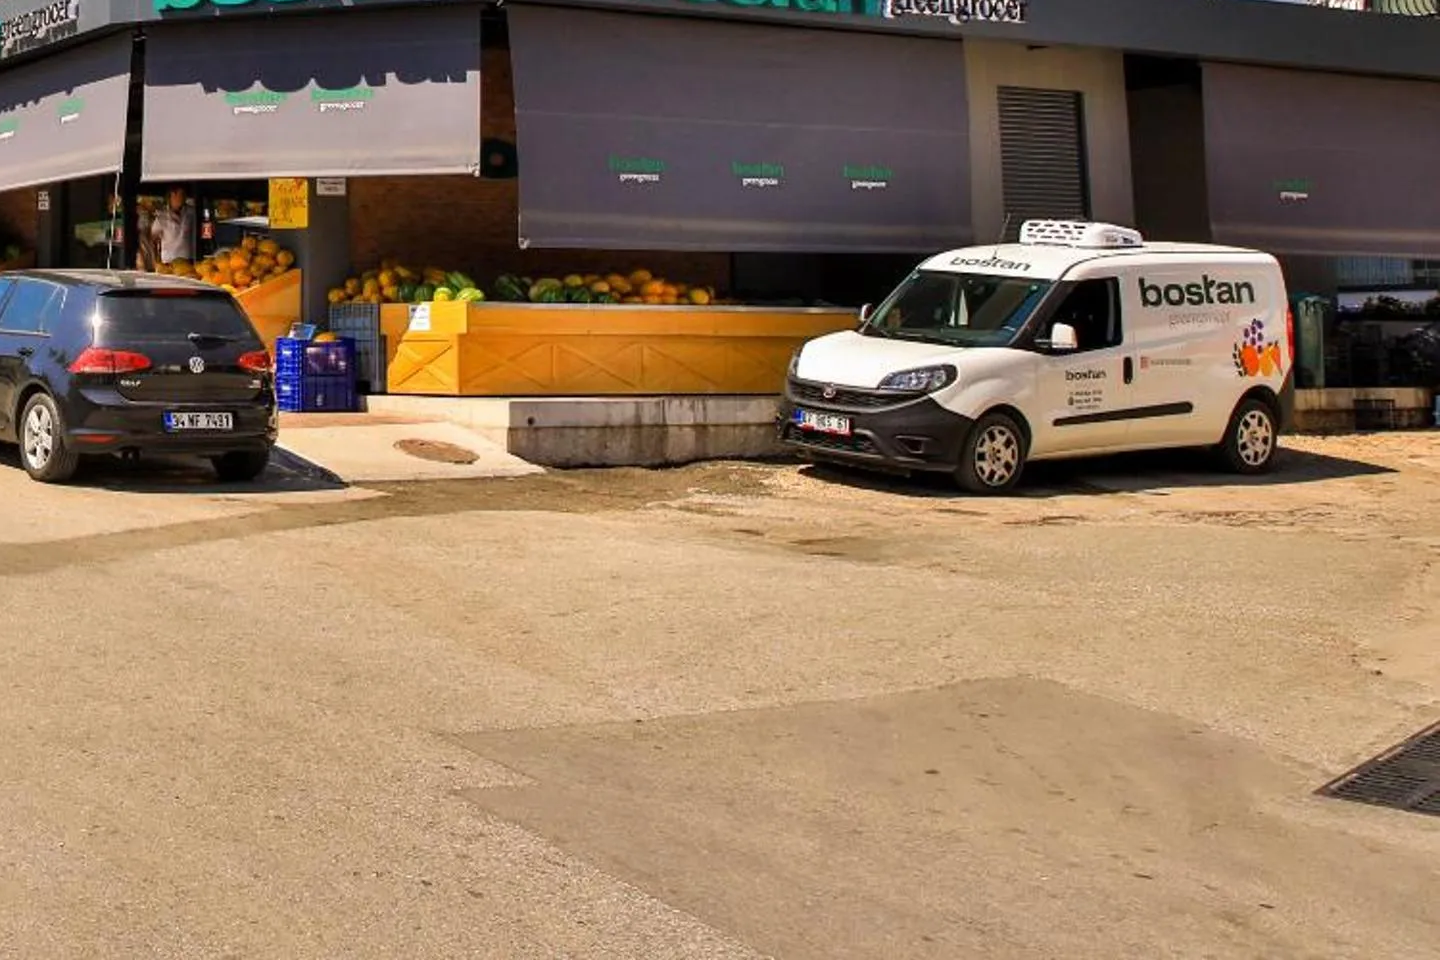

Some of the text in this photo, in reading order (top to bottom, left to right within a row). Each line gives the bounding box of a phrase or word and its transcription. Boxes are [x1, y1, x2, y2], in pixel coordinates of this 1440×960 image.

[949, 253, 1033, 272] bostan
[1138, 274, 1256, 308] bostan
[1064, 369, 1108, 382] bostan
